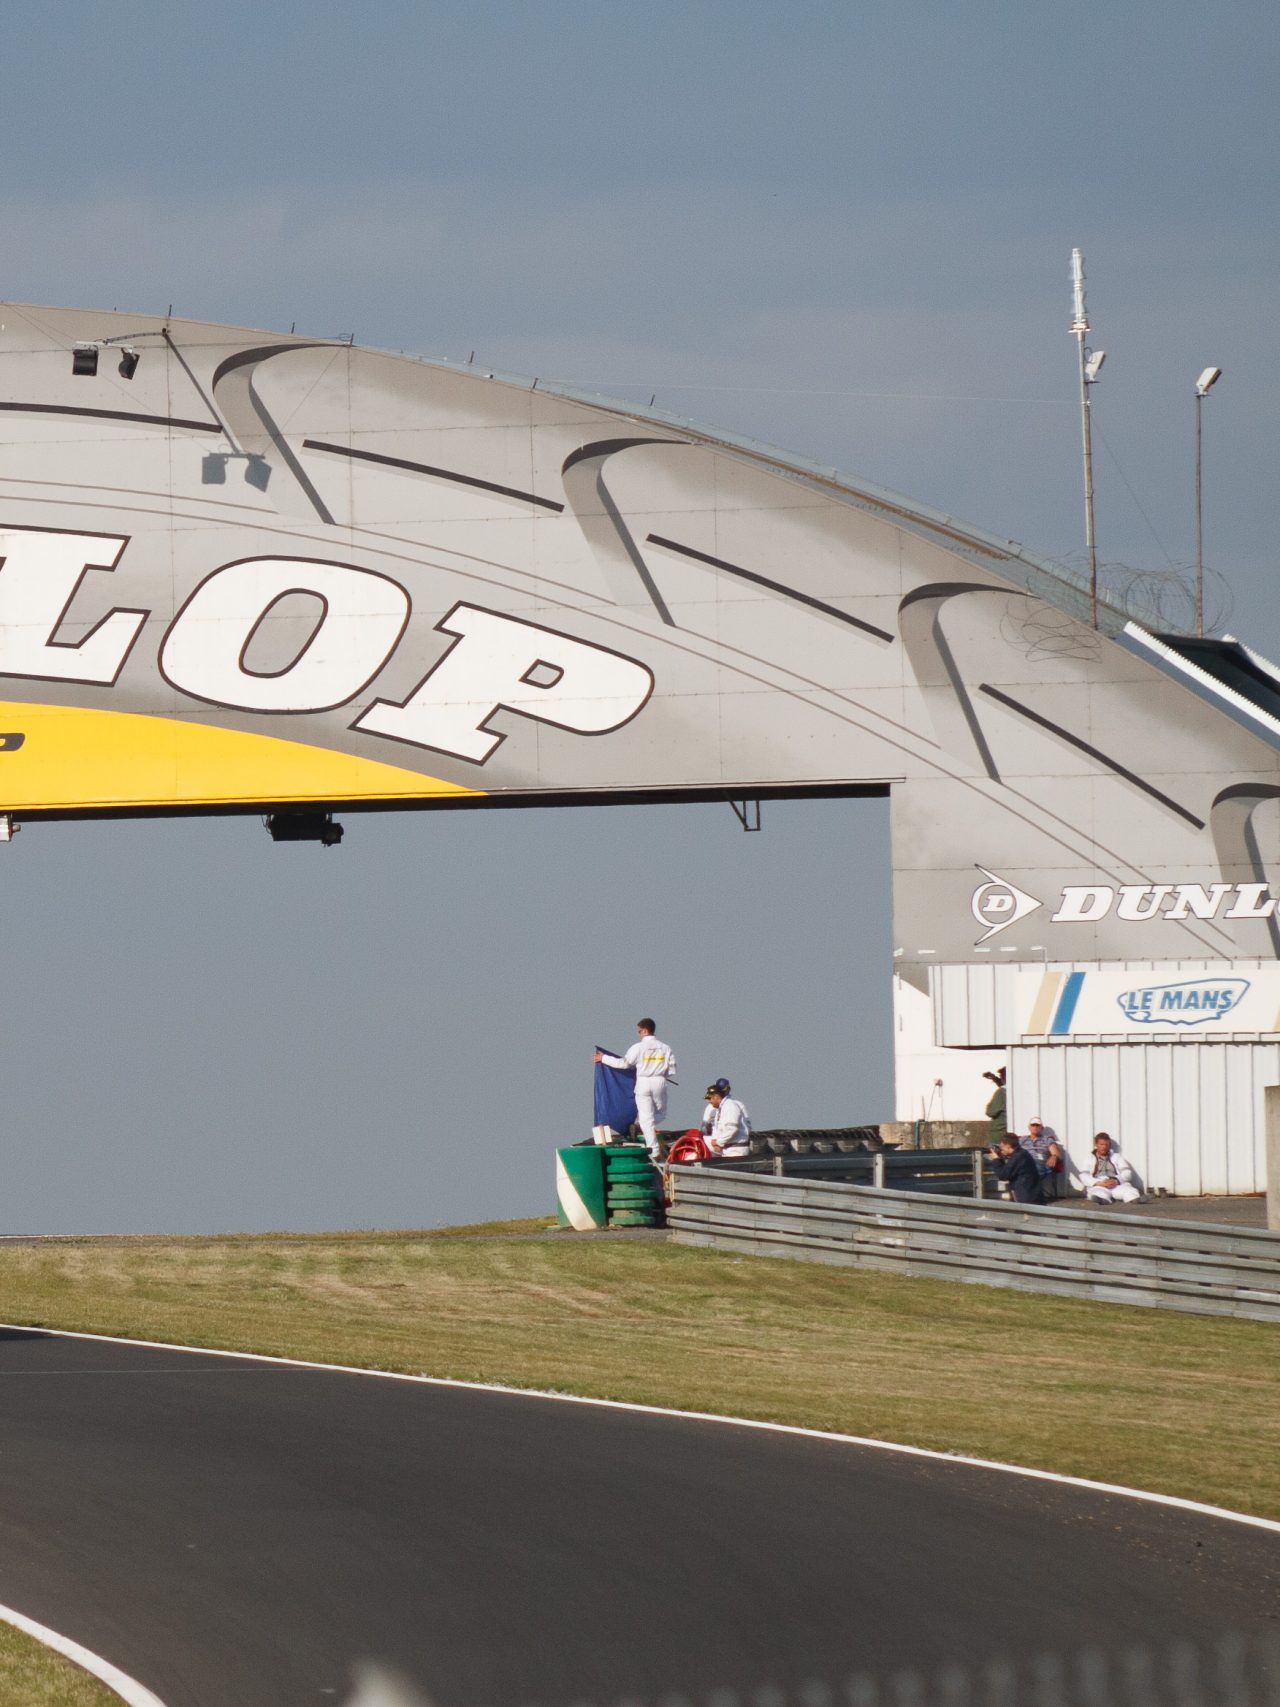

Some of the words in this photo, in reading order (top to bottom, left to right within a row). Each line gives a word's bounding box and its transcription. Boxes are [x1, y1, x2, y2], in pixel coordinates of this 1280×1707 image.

[1049, 881, 1280, 923] DUNL
[1127, 990, 1154, 1010] LE
[1159, 989, 1234, 1010] MANS
